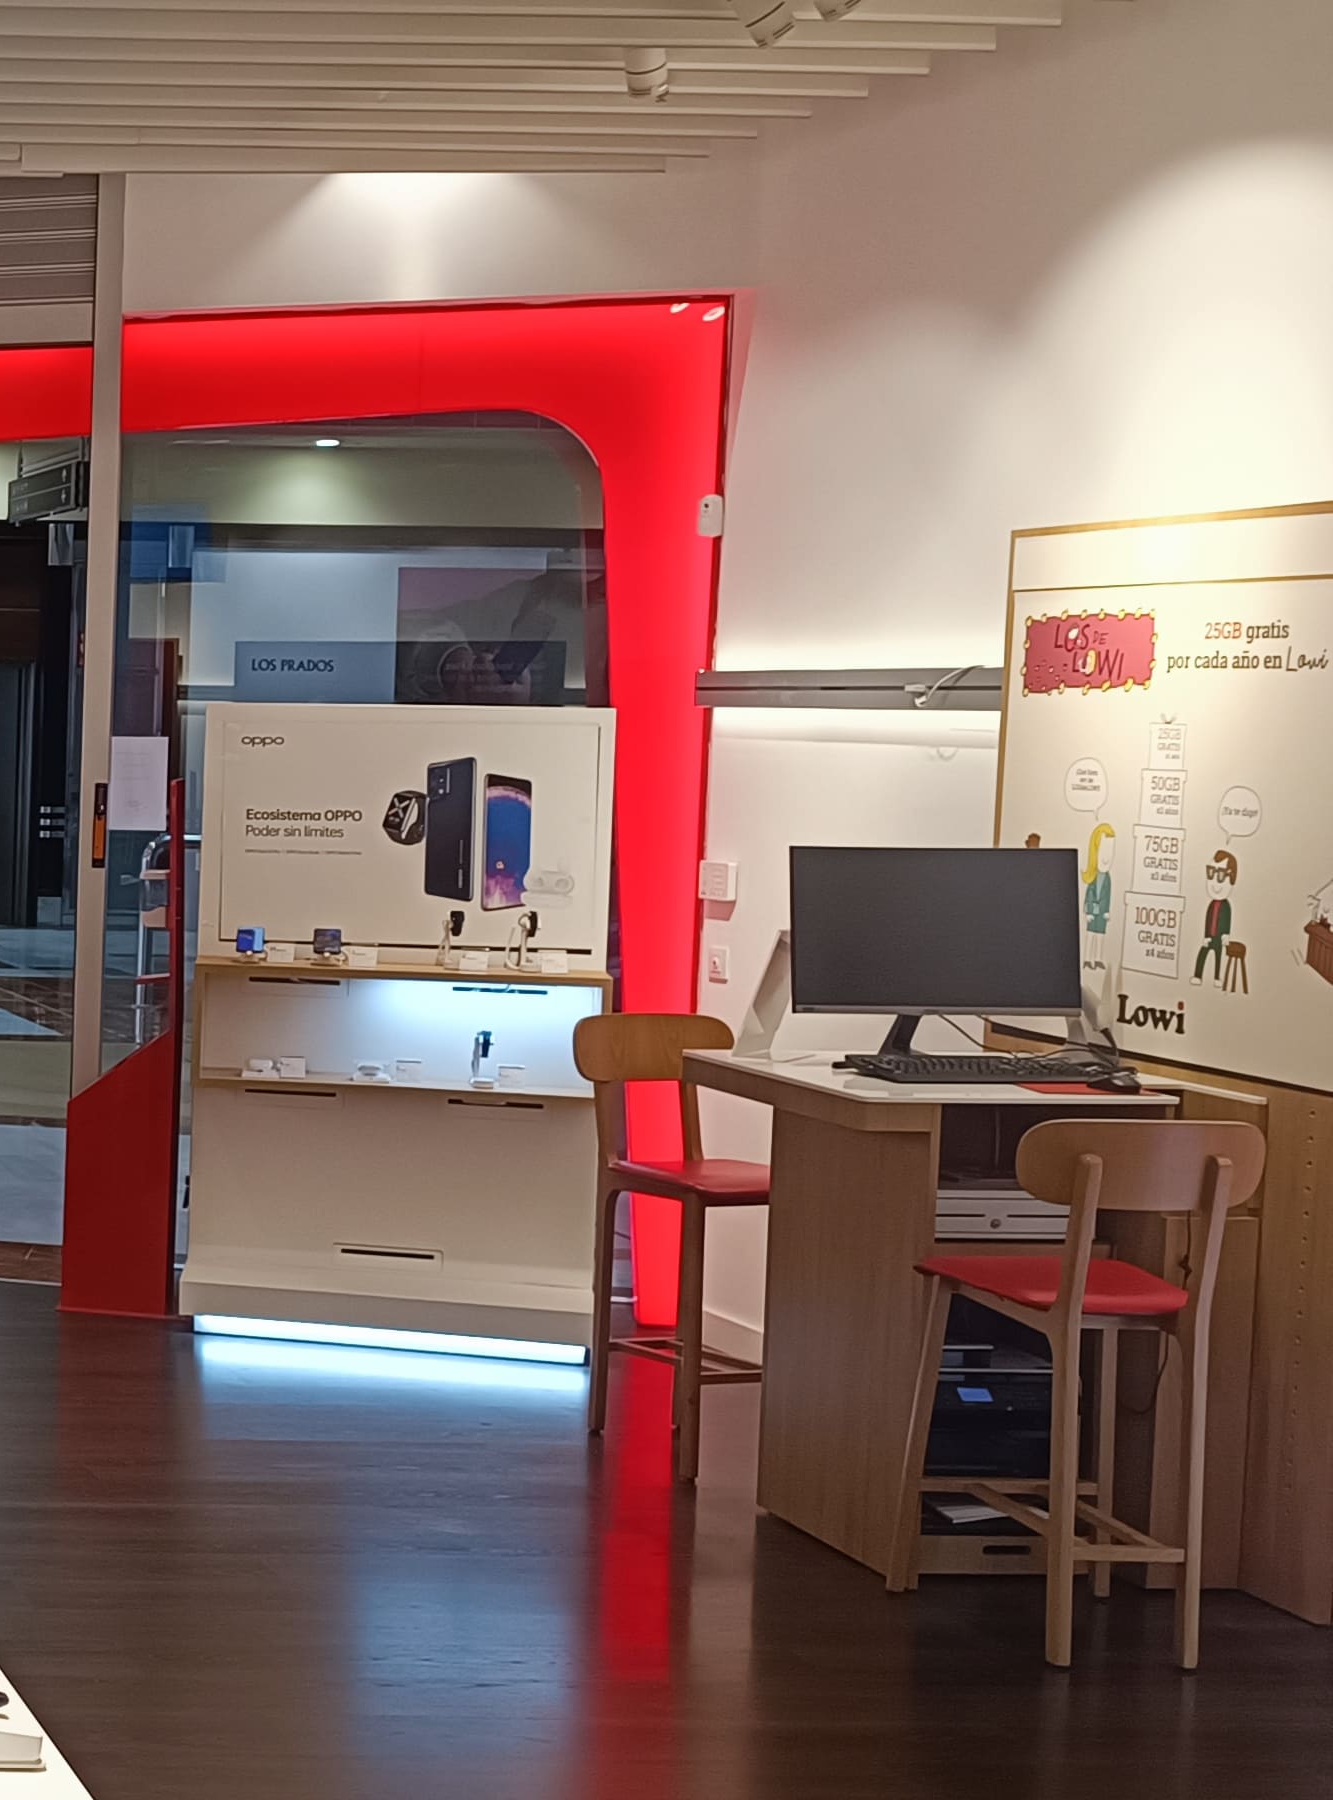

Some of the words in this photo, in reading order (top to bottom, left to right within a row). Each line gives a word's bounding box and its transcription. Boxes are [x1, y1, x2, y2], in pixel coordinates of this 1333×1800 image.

[1054, 624, 1090, 652] LOS
[1093, 630, 1110, 645] DE
[1204, 621, 1242, 640] 25GB
[1246, 619, 1290, 644] gratis
[251, 658, 277, 672] LOS
[280, 658, 335, 673] PRADOS
[1167, 655, 1191, 673] por
[1194, 650, 1228, 669] cada
[1232, 651, 1259, 669] año
[1263, 655, 1282, 669] en
[1285, 646, 1329, 672] Lowi
[241, 736, 285, 748] oppo
[1151, 776, 1180, 792] 50GB
[1150, 794, 1180, 805] GRATIS
[245, 808, 322, 821] Ecosistema
[324, 809, 363, 822] OPPO
[245, 824, 281, 837] Poder
[283, 825, 302, 837] sin
[1144, 835, 1179, 855] 75GB
[1143, 856, 1179, 871] GRATIS
[1135, 906, 1177, 929] 100GB
[1138, 930, 1176, 948] GRATIS
[1116, 993, 1185, 1035] Lowi
